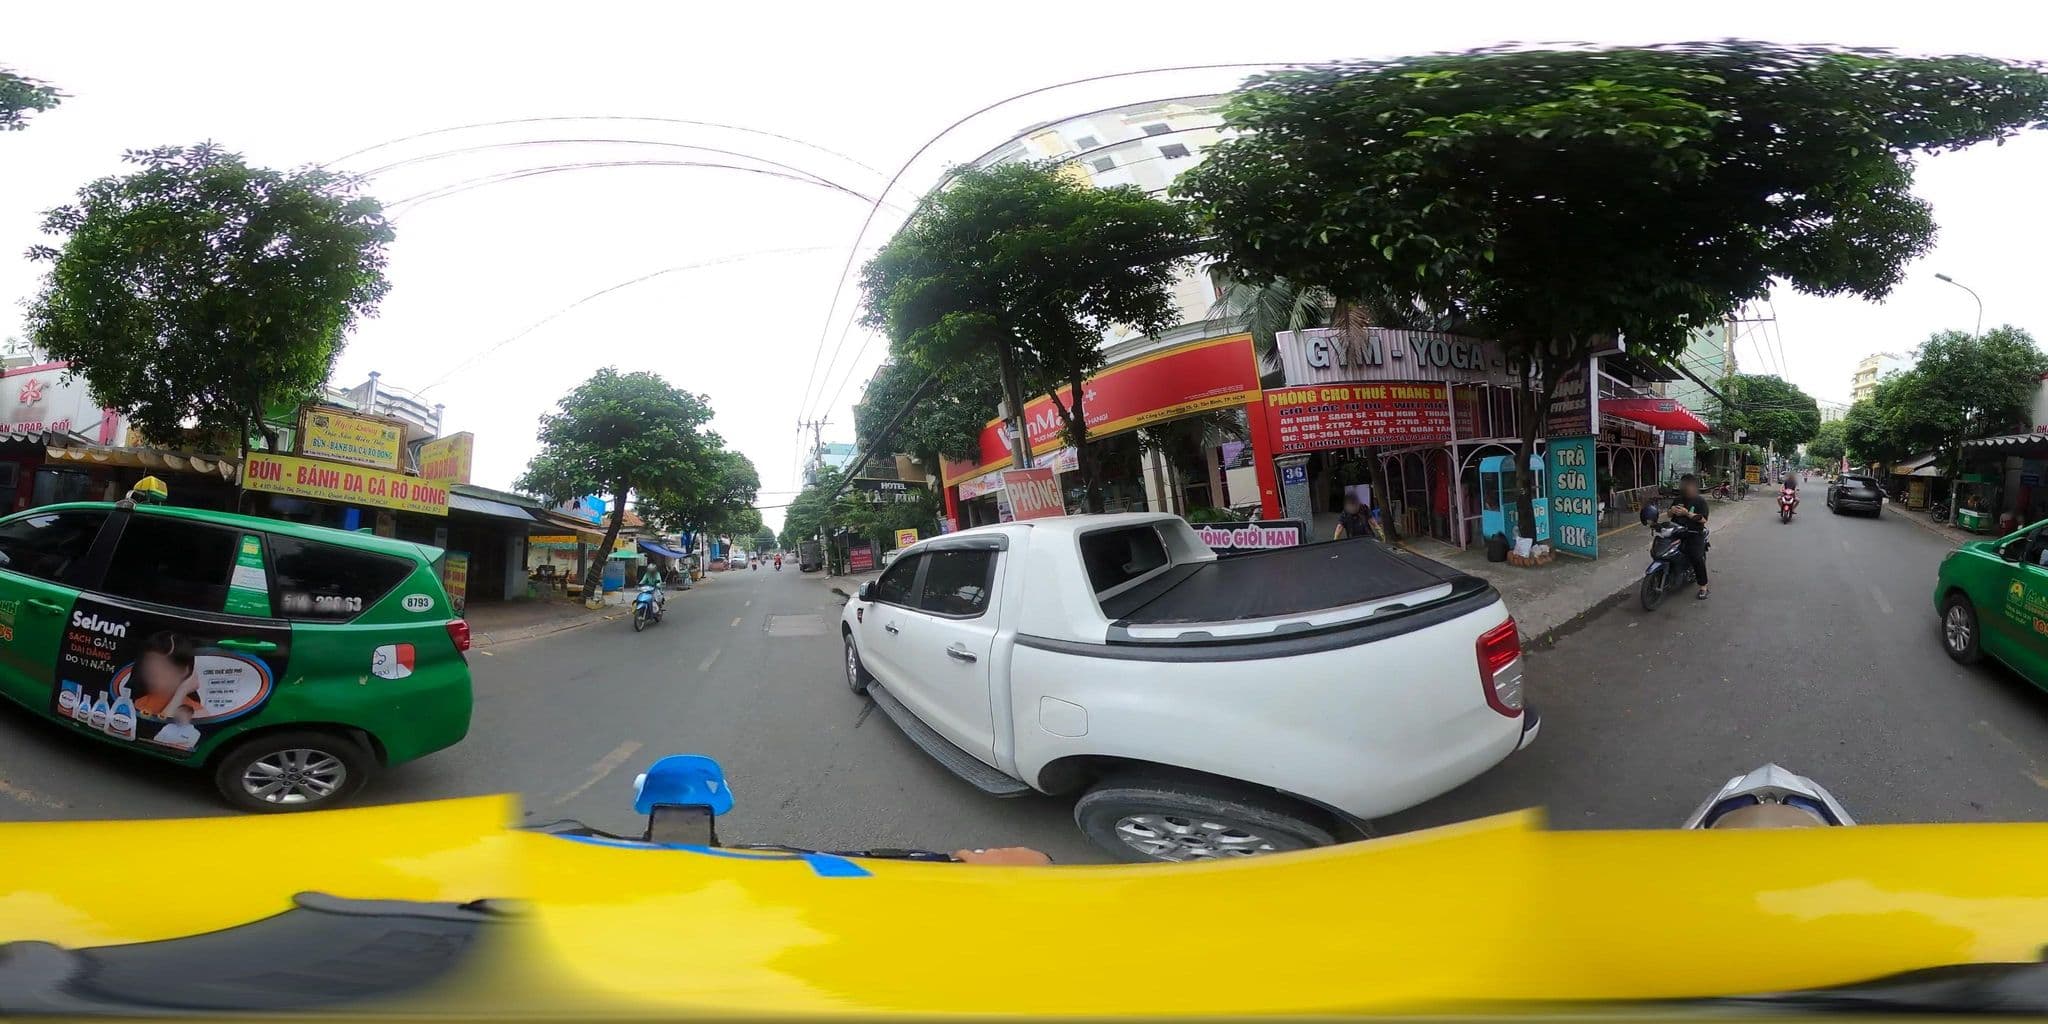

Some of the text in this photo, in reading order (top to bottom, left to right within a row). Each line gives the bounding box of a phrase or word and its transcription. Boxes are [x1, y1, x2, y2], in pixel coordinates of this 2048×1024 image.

[1305, 336, 1383, 369] GYM
[1410, 336, 1486, 371] YOGA
[1321, 388, 1349, 402] CHO
[1557, 445, 1586, 466] TRÀ
[249, 458, 282, 481] BÚN
[297, 464, 340, 489] BÁNH
[344, 472, 363, 492] ĐA
[368, 475, 386, 496] CÁ
[391, 479, 408, 500] RÔ
[1286, 467, 1303, 479] 36
[1558, 470, 1587, 490] SỮA
[880, 482, 907, 490] HOTEL
[1007, 473, 1065, 513] PHÒNG
[1554, 497, 1593, 516] SẠCH
[1234, 526, 1262, 546] GIỚI
[407, 598, 429, 608] 8793
[72, 610, 126, 638] Selsun
[66, 654, 78, 663] DO
[80, 657, 89, 667] VI
